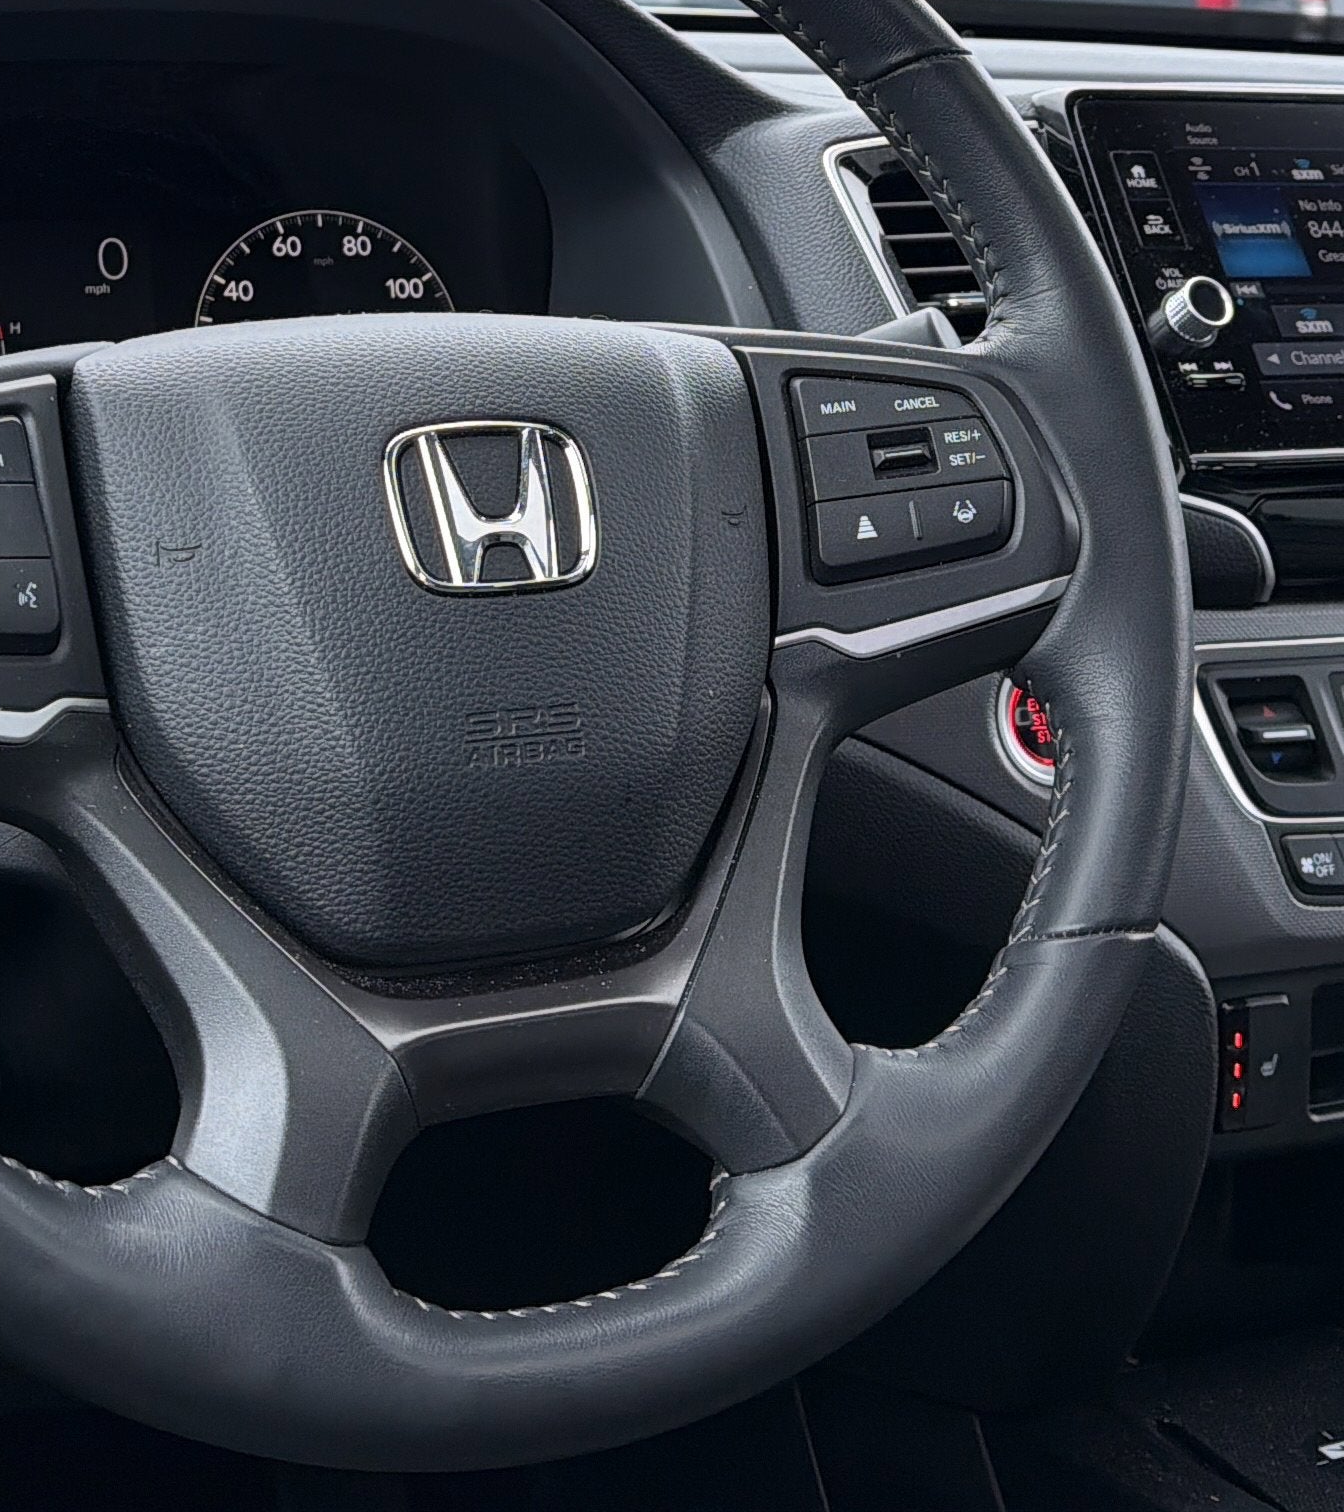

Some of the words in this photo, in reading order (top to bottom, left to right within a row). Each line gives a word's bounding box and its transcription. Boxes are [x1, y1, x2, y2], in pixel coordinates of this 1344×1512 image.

[1126, 178, 1158, 188] HOME
[1143, 224, 1173, 235] BACK
[272, 236, 302, 257] 60
[342, 236, 372, 257] 80
[98, 237, 129, 280] 0
[1162, 267, 1184, 278] VOL
[85, 283, 111, 296] mph
[223, 280, 254, 301] 40
[385, 278, 424, 299] 100
[9, 322, 21, 335] H
[820, 399, 856, 415] MAIN
[894, 396, 940, 412] CANCEL
[944, 429, 981, 444] RES/+
[465, 702, 582, 736] SRS
[468, 737, 586, 768] AIRBAG
[1315, 864, 1335, 877] OFF
